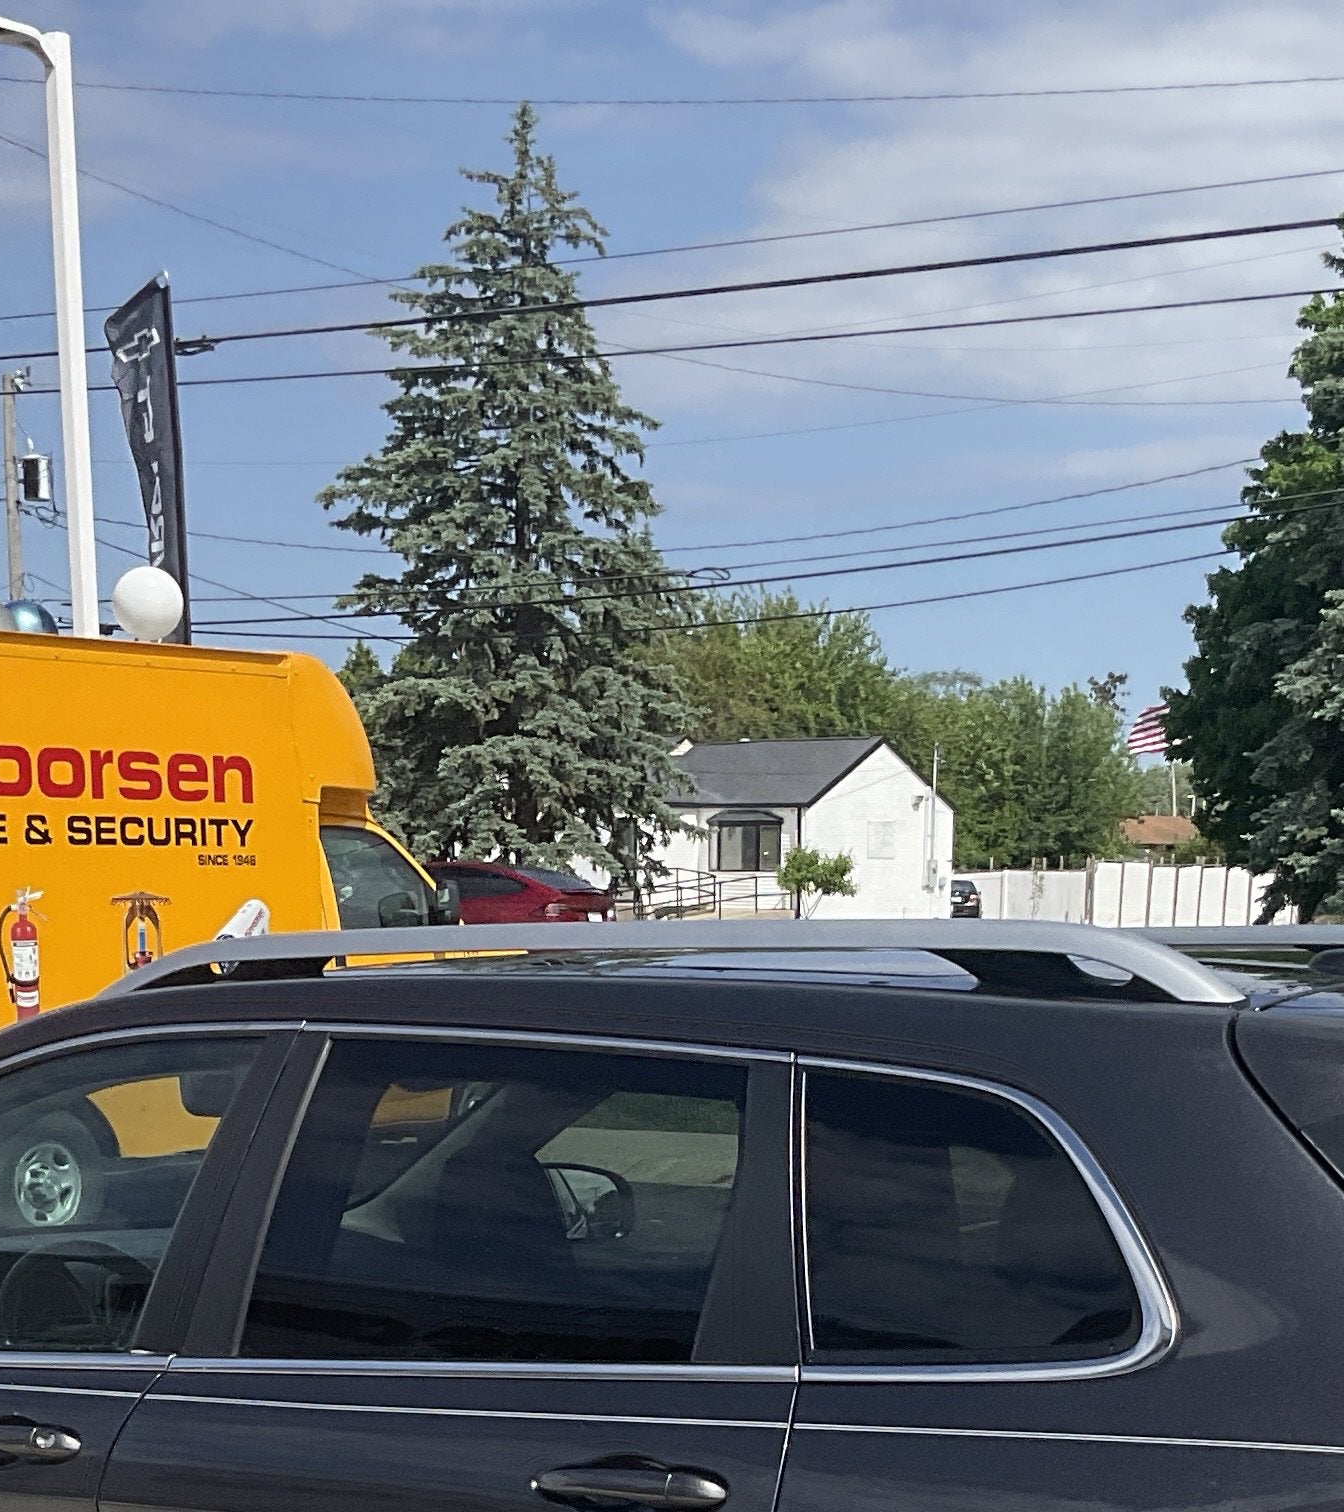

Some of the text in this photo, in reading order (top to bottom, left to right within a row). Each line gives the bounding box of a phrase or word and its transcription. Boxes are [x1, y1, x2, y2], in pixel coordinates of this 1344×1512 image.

[24, 813, 53, 846] &
[67, 815, 254, 848] SECURITY
[197, 854, 257, 867] SINCE 1946
